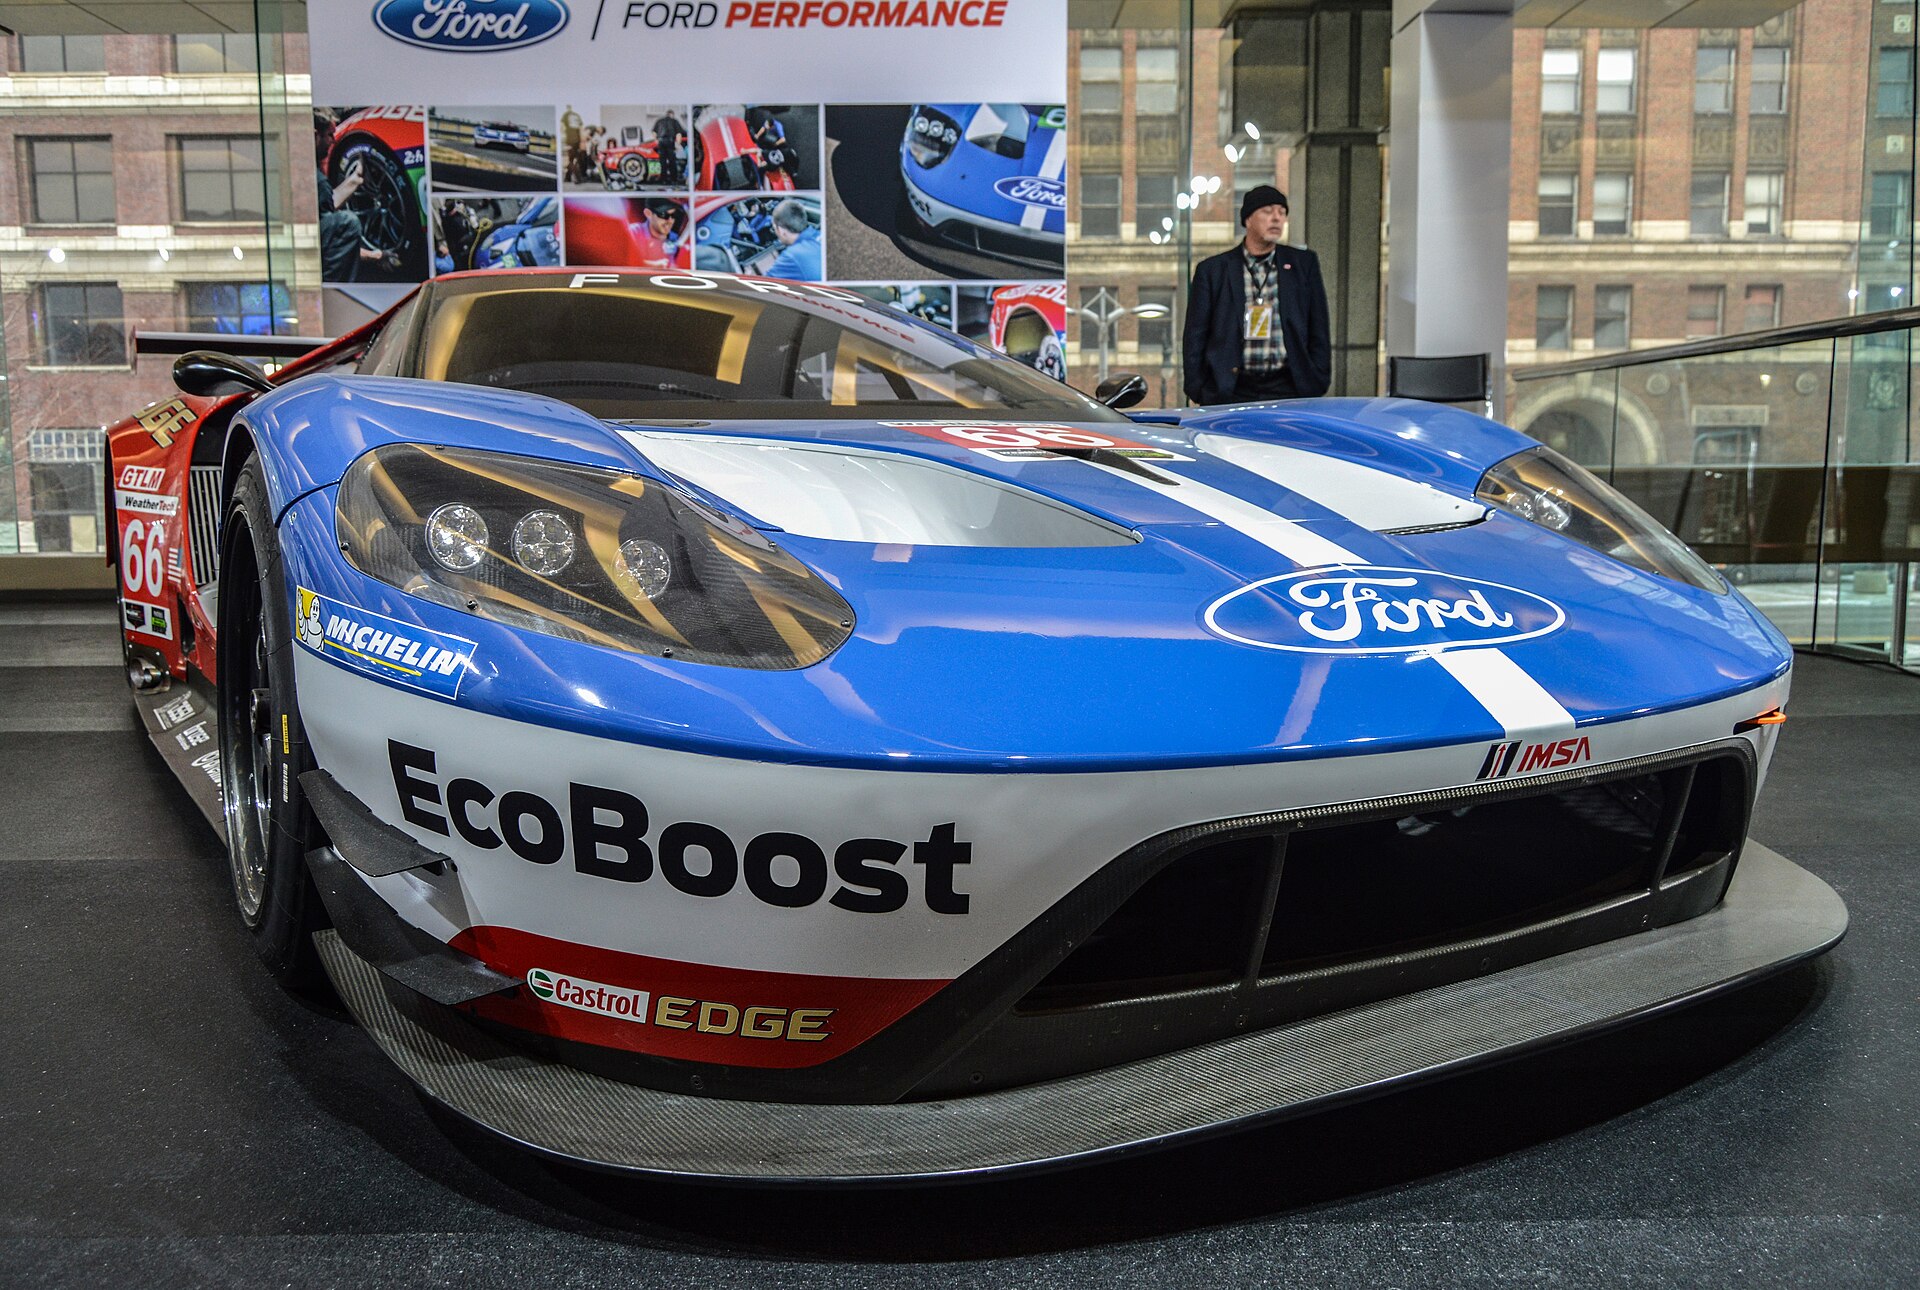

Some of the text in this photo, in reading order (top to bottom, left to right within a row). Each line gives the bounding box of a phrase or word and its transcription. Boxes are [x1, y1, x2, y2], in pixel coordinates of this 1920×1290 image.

[411, 0, 530, 40] Ford
[622, 1, 1008, 28] FORD PERFORMANCE
[569, 270, 865, 304] FORD
[941, 426, 1115, 448] 66
[121, 467, 163, 490] GTLM
[125, 494, 176, 513] WeatherTech
[122, 518, 165, 598] 66
[1299, 576, 1515, 643] Ford
[325, 614, 464, 677] MICHELIN
[1516, 735, 1592, 774] IMSA
[387, 738, 973, 916] EcoBoost
[555, 977, 836, 1042] Castrol EDGE
